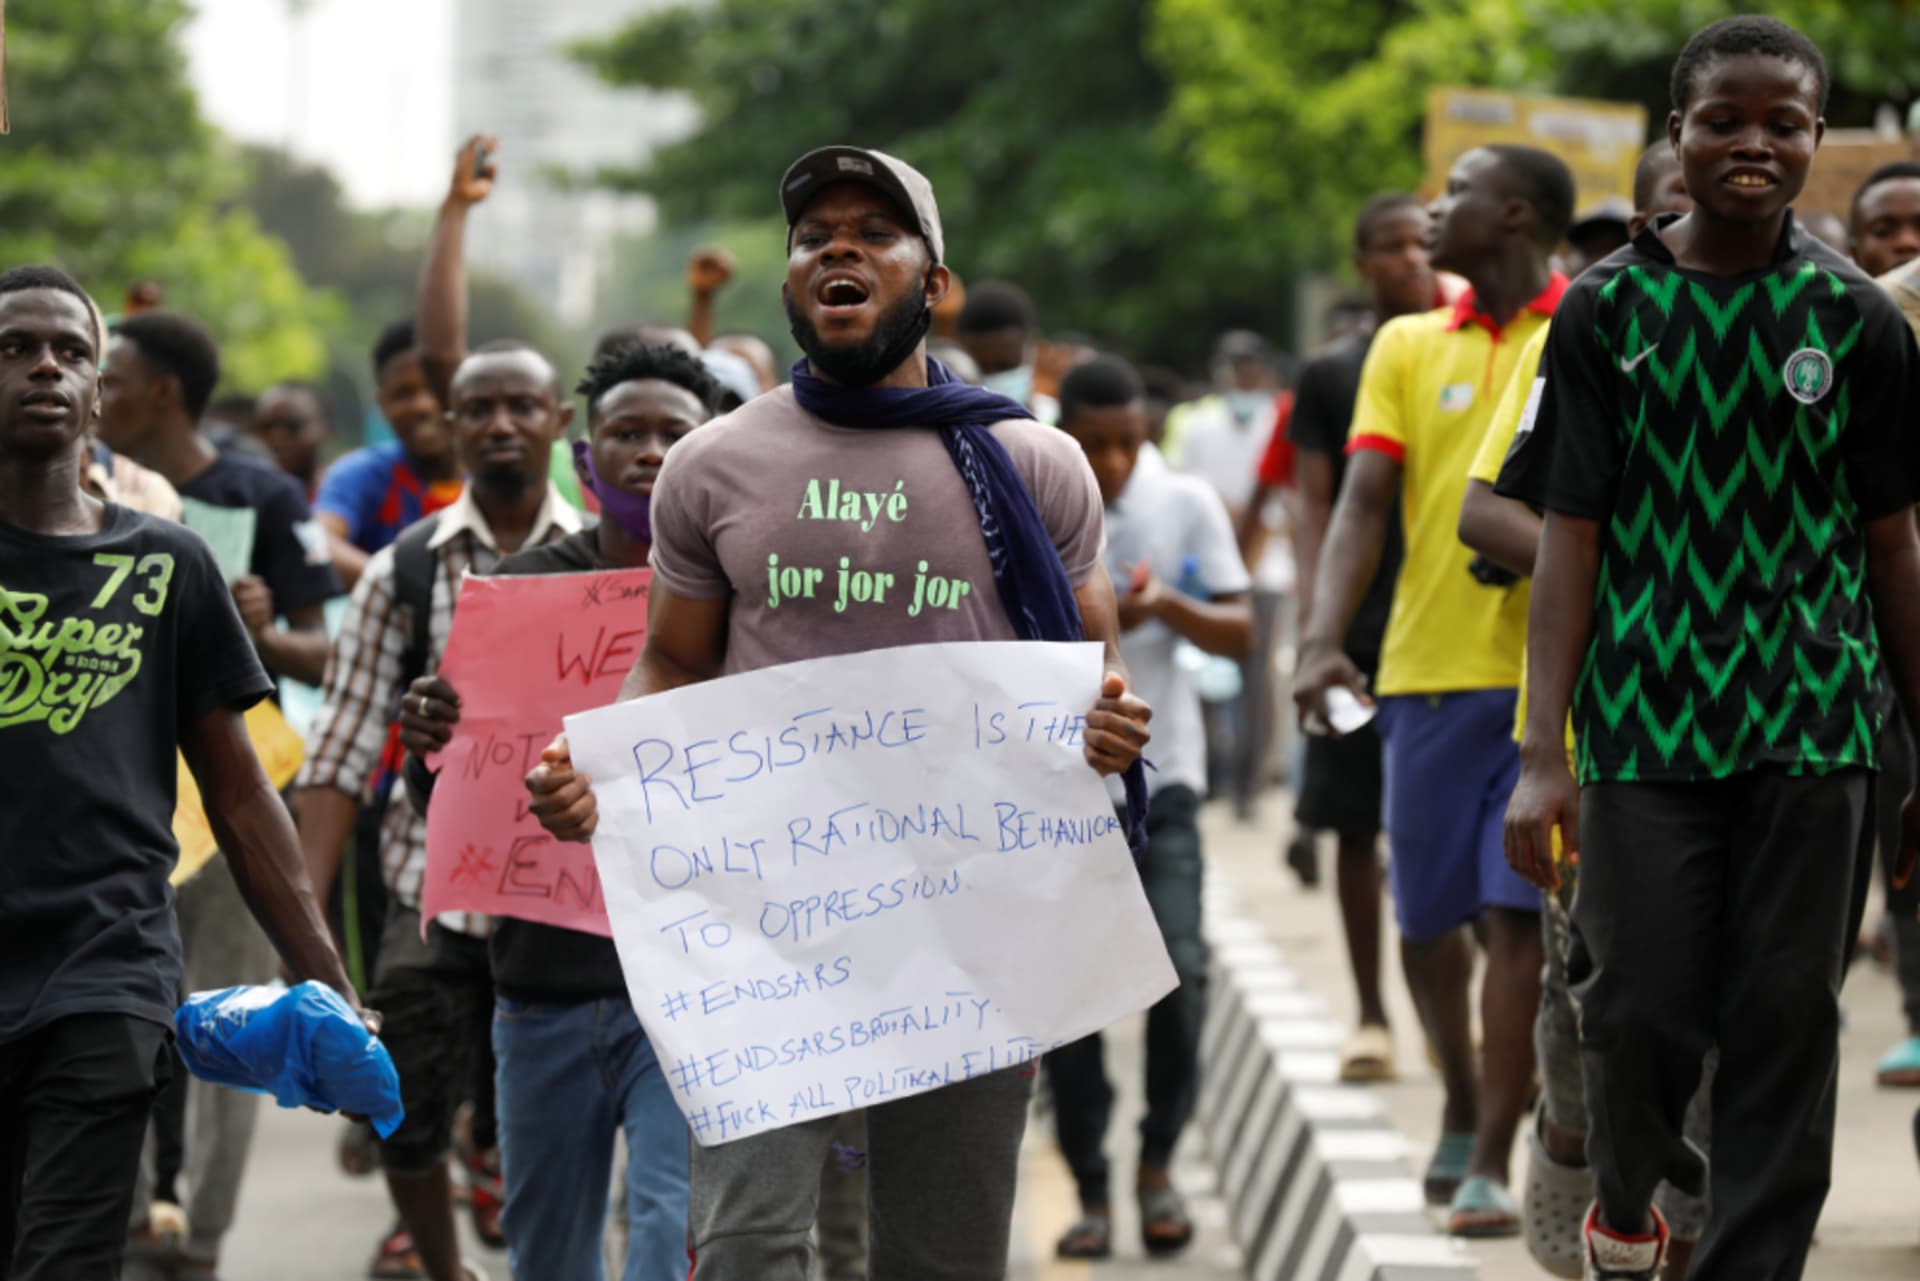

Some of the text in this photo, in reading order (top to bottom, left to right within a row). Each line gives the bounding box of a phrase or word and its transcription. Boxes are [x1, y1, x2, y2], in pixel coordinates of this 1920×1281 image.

[797, 479, 908, 533] Alayé
[90, 553, 175, 616] 73
[768, 553, 970, 617] jor jor jor
[556, 626, 644, 685] WE
[463, 732, 546, 780] NOT
[632, 701, 1087, 824] RESISTANCE IS THE
[449, 834, 608, 914] #EN
[650, 801, 1121, 890] ONLY RATIONAL BEHAVIOR
[660, 910, 732, 954] TO
[660, 956, 852, 1021] #ENDSARS
[788, 1082, 835, 1118] ALL
